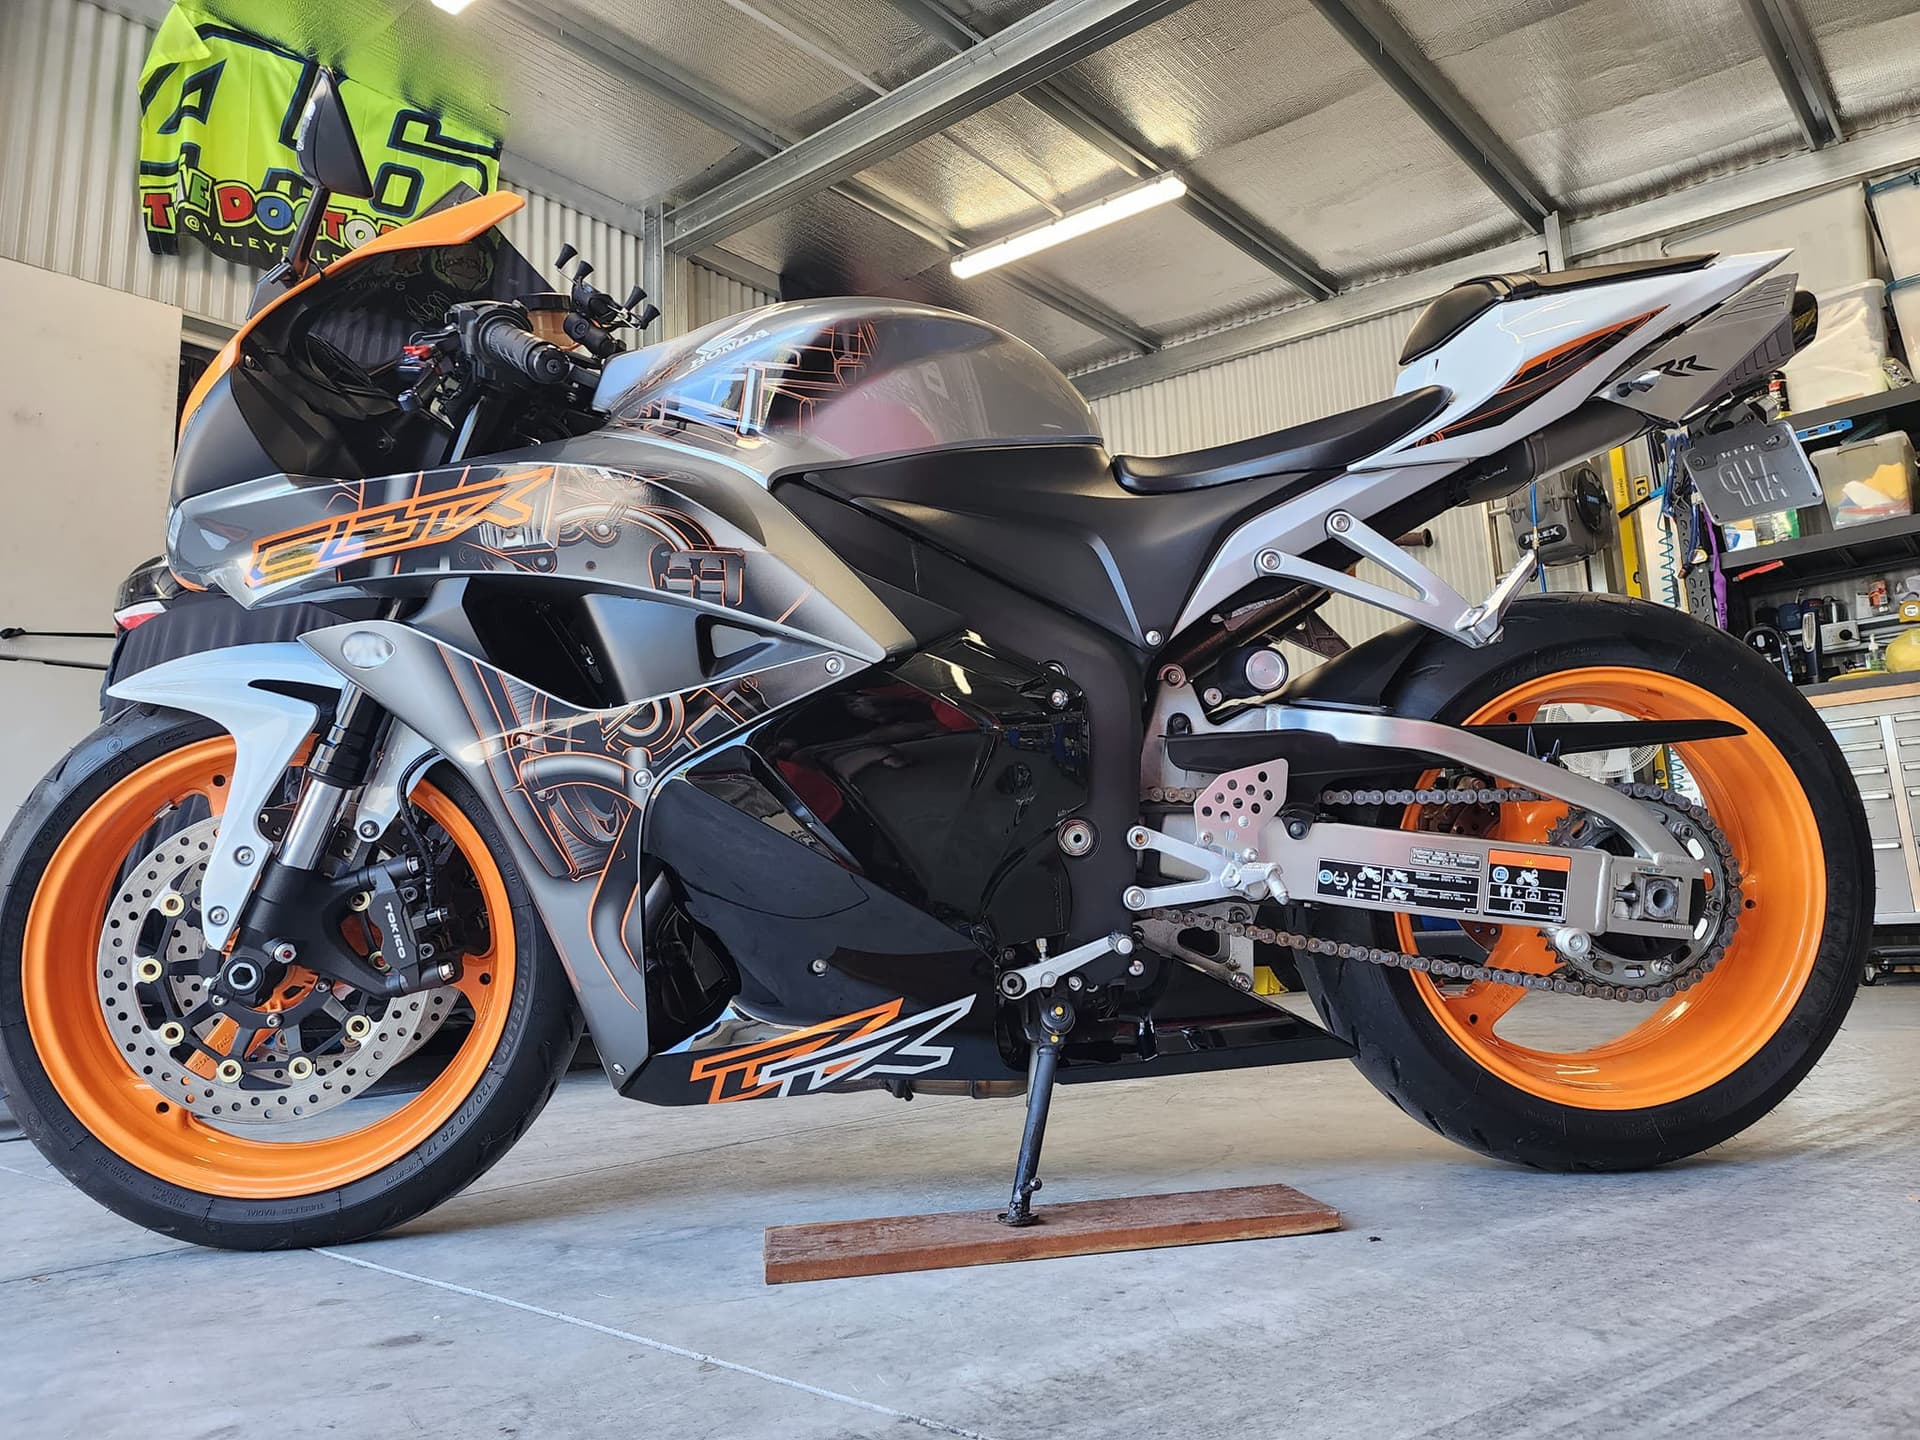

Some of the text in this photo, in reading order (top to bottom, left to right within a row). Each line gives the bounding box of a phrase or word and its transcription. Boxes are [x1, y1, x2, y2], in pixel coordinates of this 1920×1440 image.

[143, 168, 398, 248] TE DOTO
[690, 329, 771, 369] HONDA
[1653, 354, 1717, 377] RR
[384, 901, 407, 959] TOKICO
[500, 949, 529, 1060] MICHELIN
[426, 1081, 491, 1157] 120/70 ZR 17
